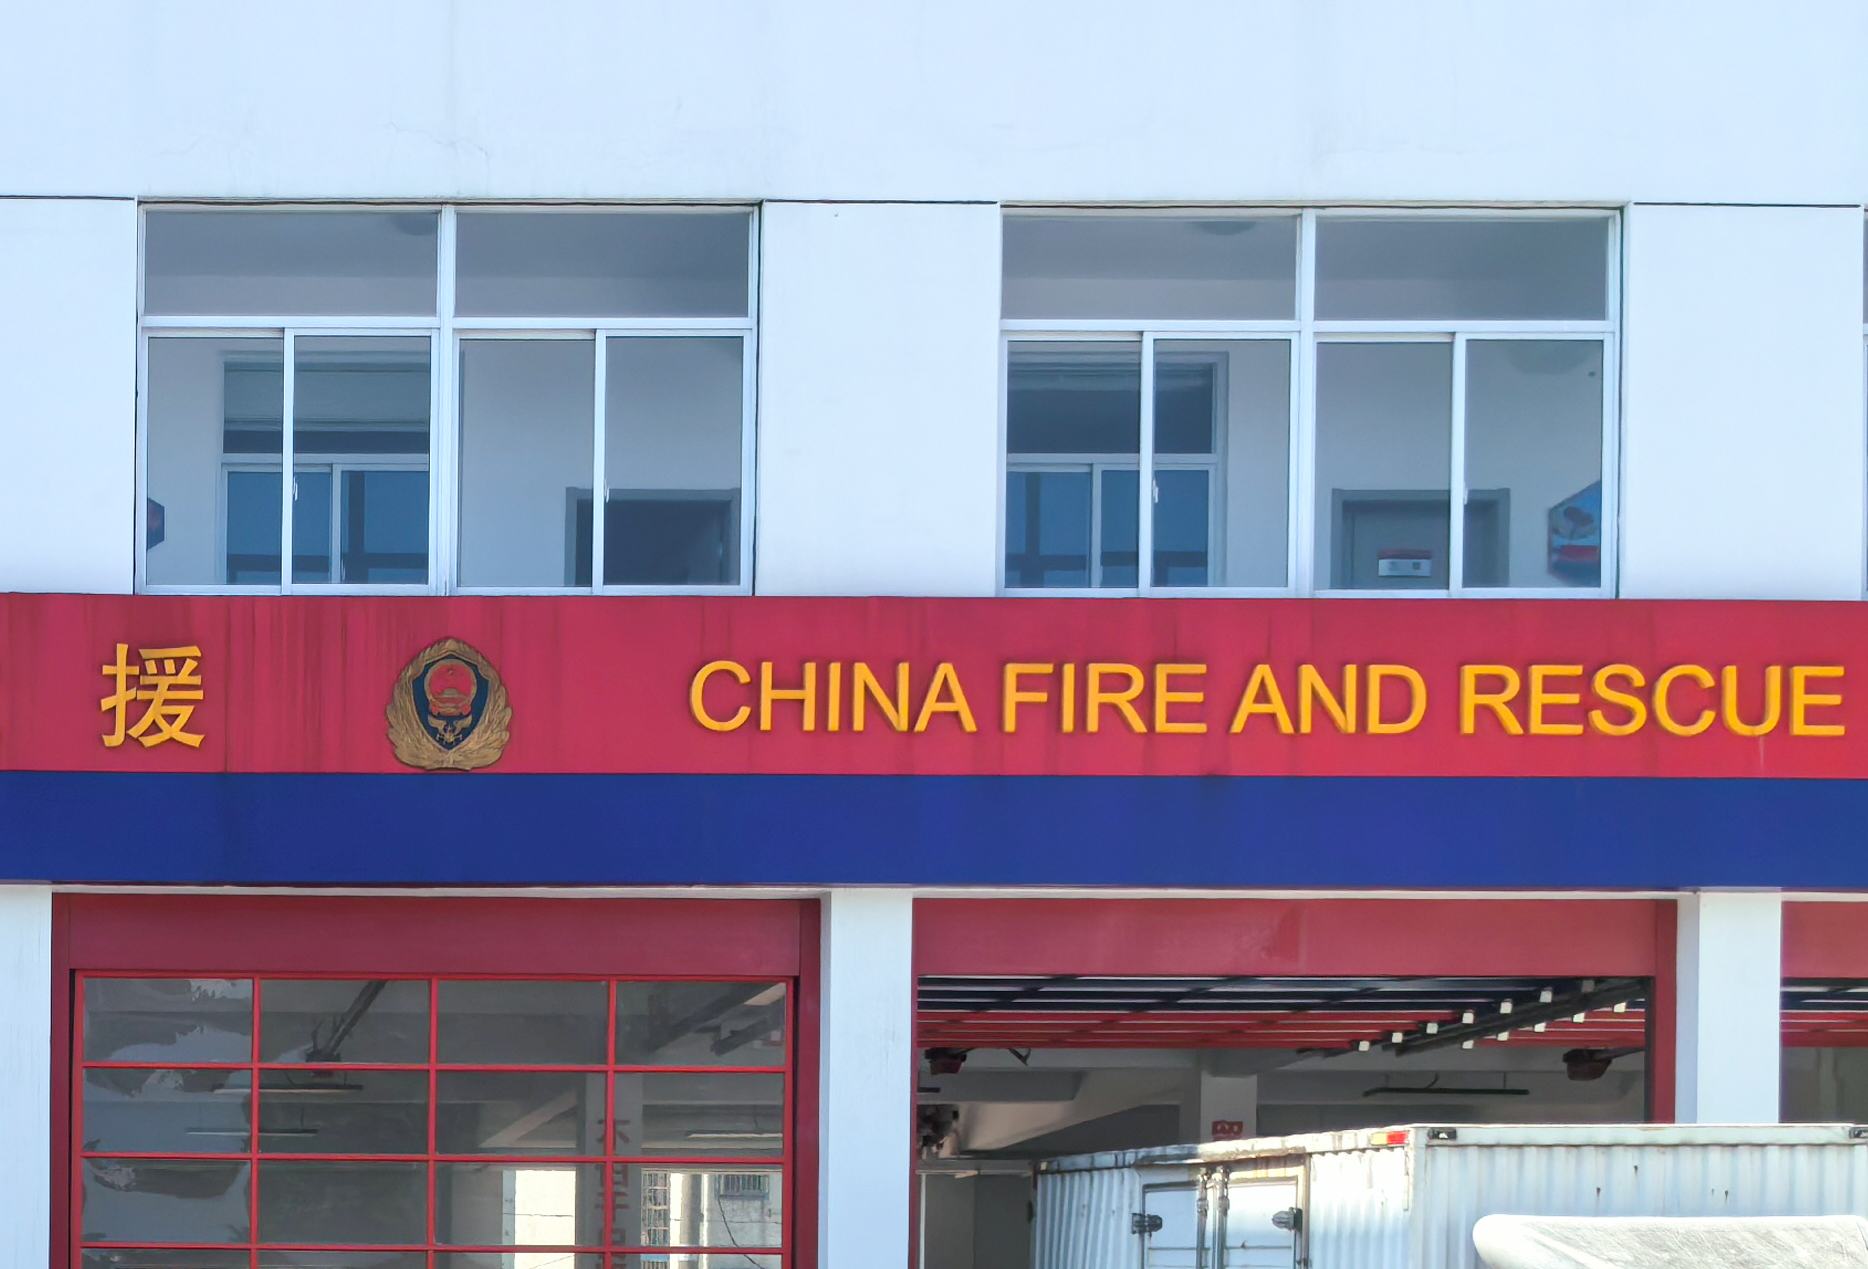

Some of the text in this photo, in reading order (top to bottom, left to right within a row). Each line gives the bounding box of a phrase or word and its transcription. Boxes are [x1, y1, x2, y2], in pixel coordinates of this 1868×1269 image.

[689, 660, 1846, 738] CHINA FIRE AND RESCUE
